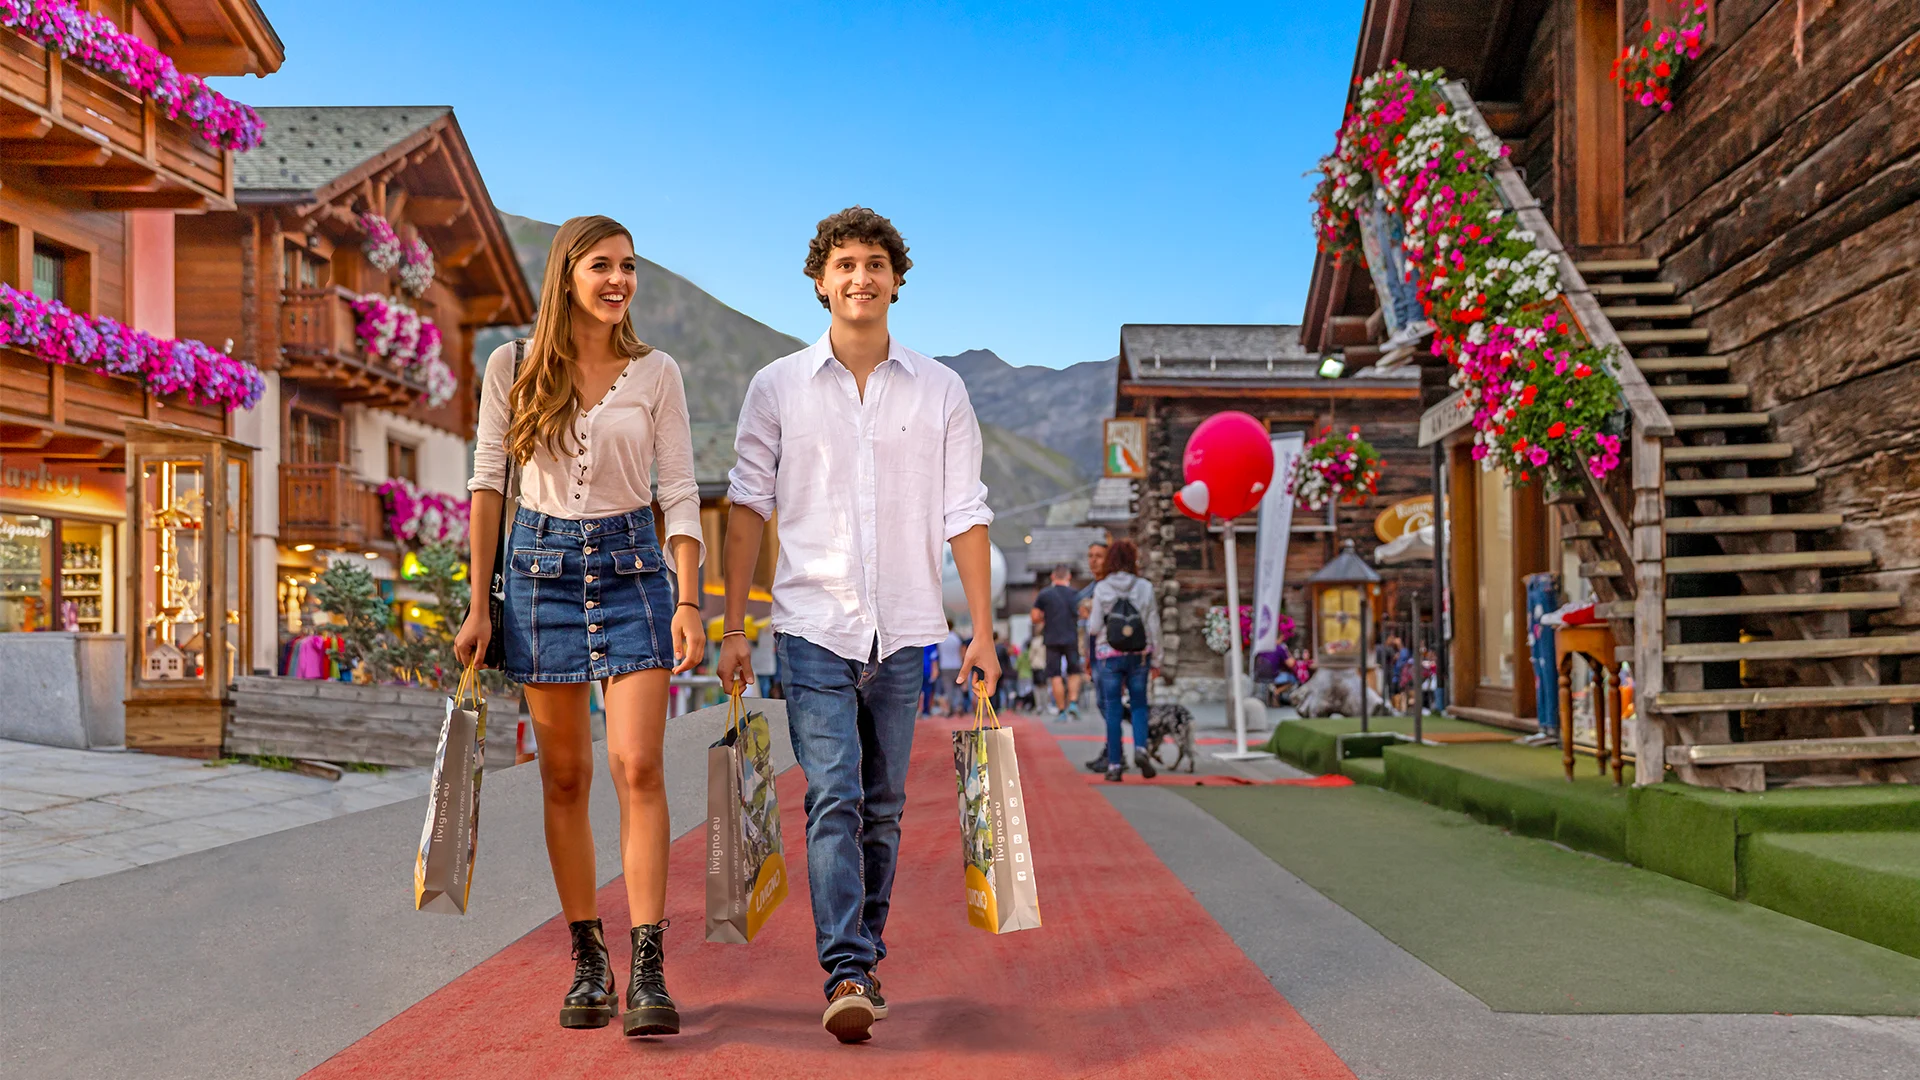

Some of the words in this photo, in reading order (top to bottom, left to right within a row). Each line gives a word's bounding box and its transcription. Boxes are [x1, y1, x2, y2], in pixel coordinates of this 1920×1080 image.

[434, 783, 450, 842] livigno.eu
[995, 801, 1005, 861] livigno.eu
[709, 816, 723, 874] livigno.eu
